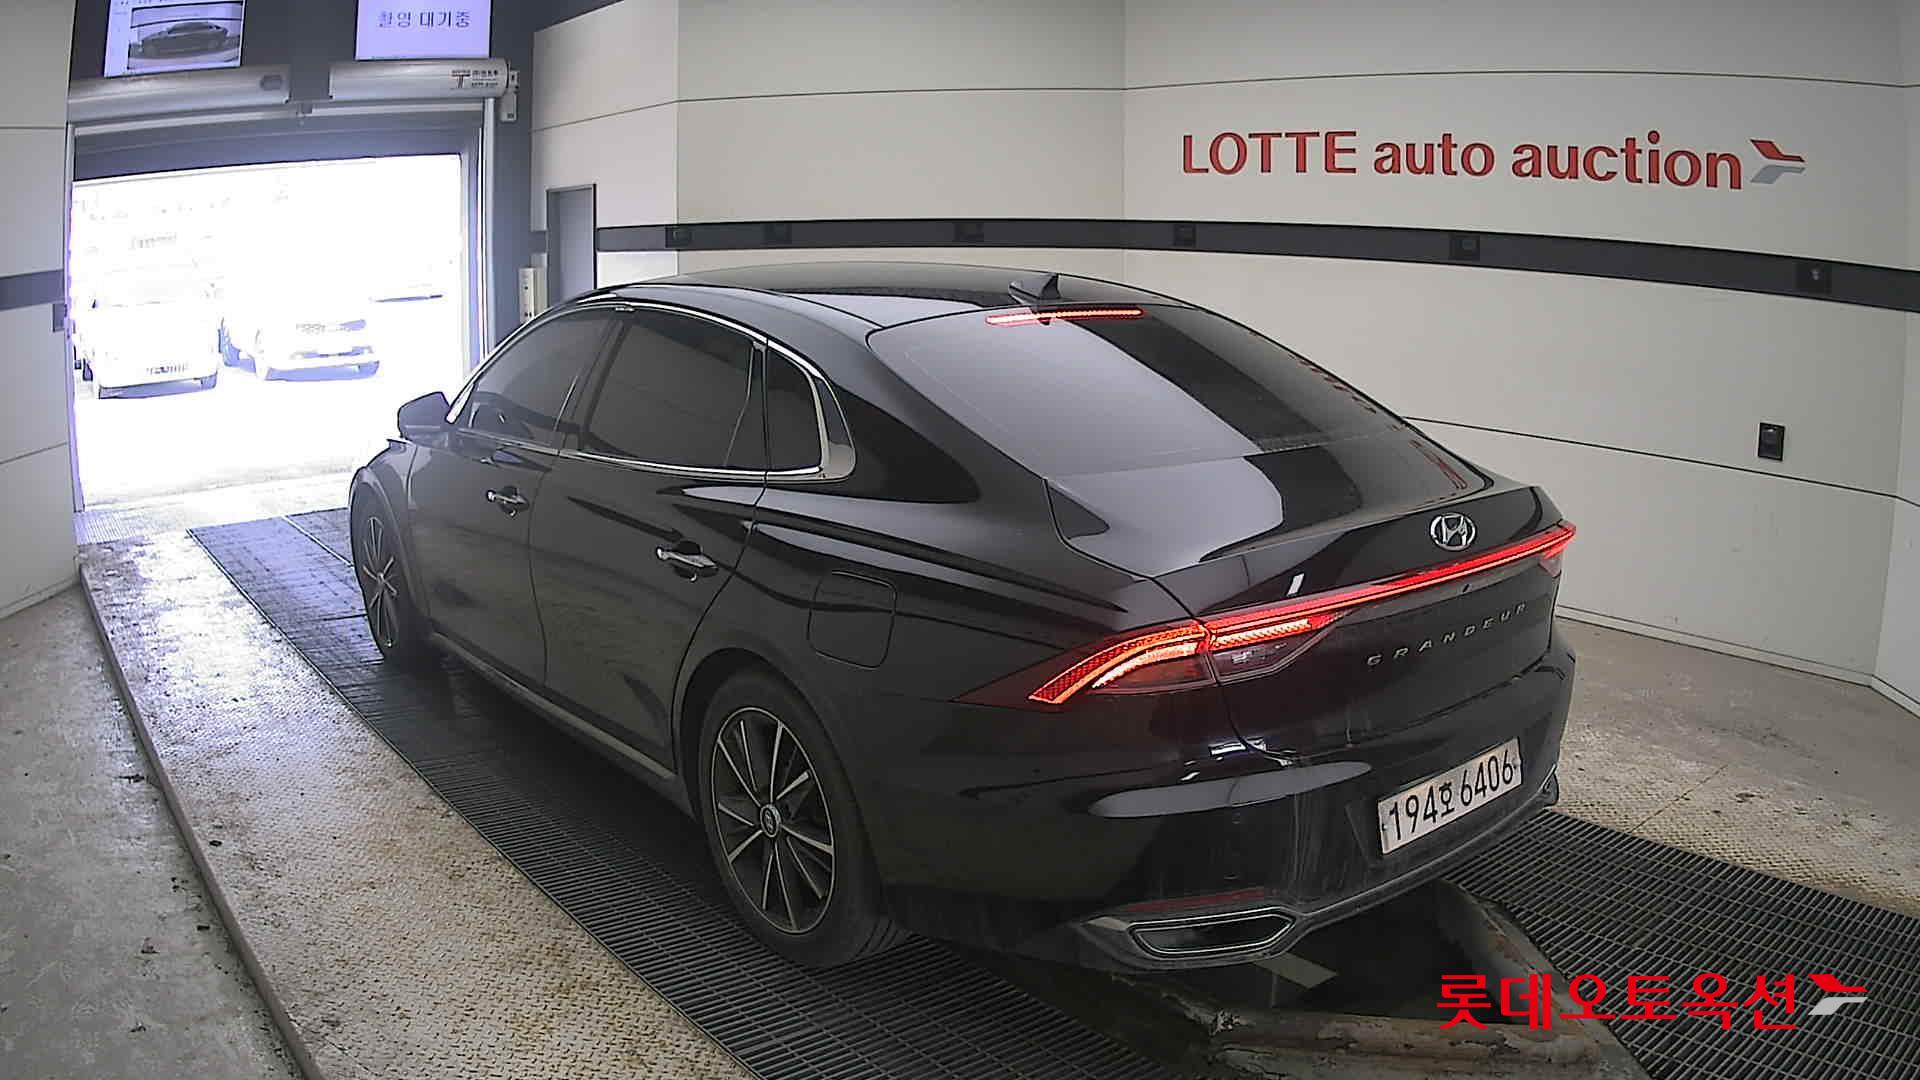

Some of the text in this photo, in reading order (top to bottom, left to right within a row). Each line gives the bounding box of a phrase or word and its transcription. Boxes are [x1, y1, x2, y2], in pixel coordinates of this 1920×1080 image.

[419, 10, 471, 28] 대기중
[1183, 130, 1743, 190] LOTTE auto auction
[1366, 602, 1526, 667] GRANDEUR
